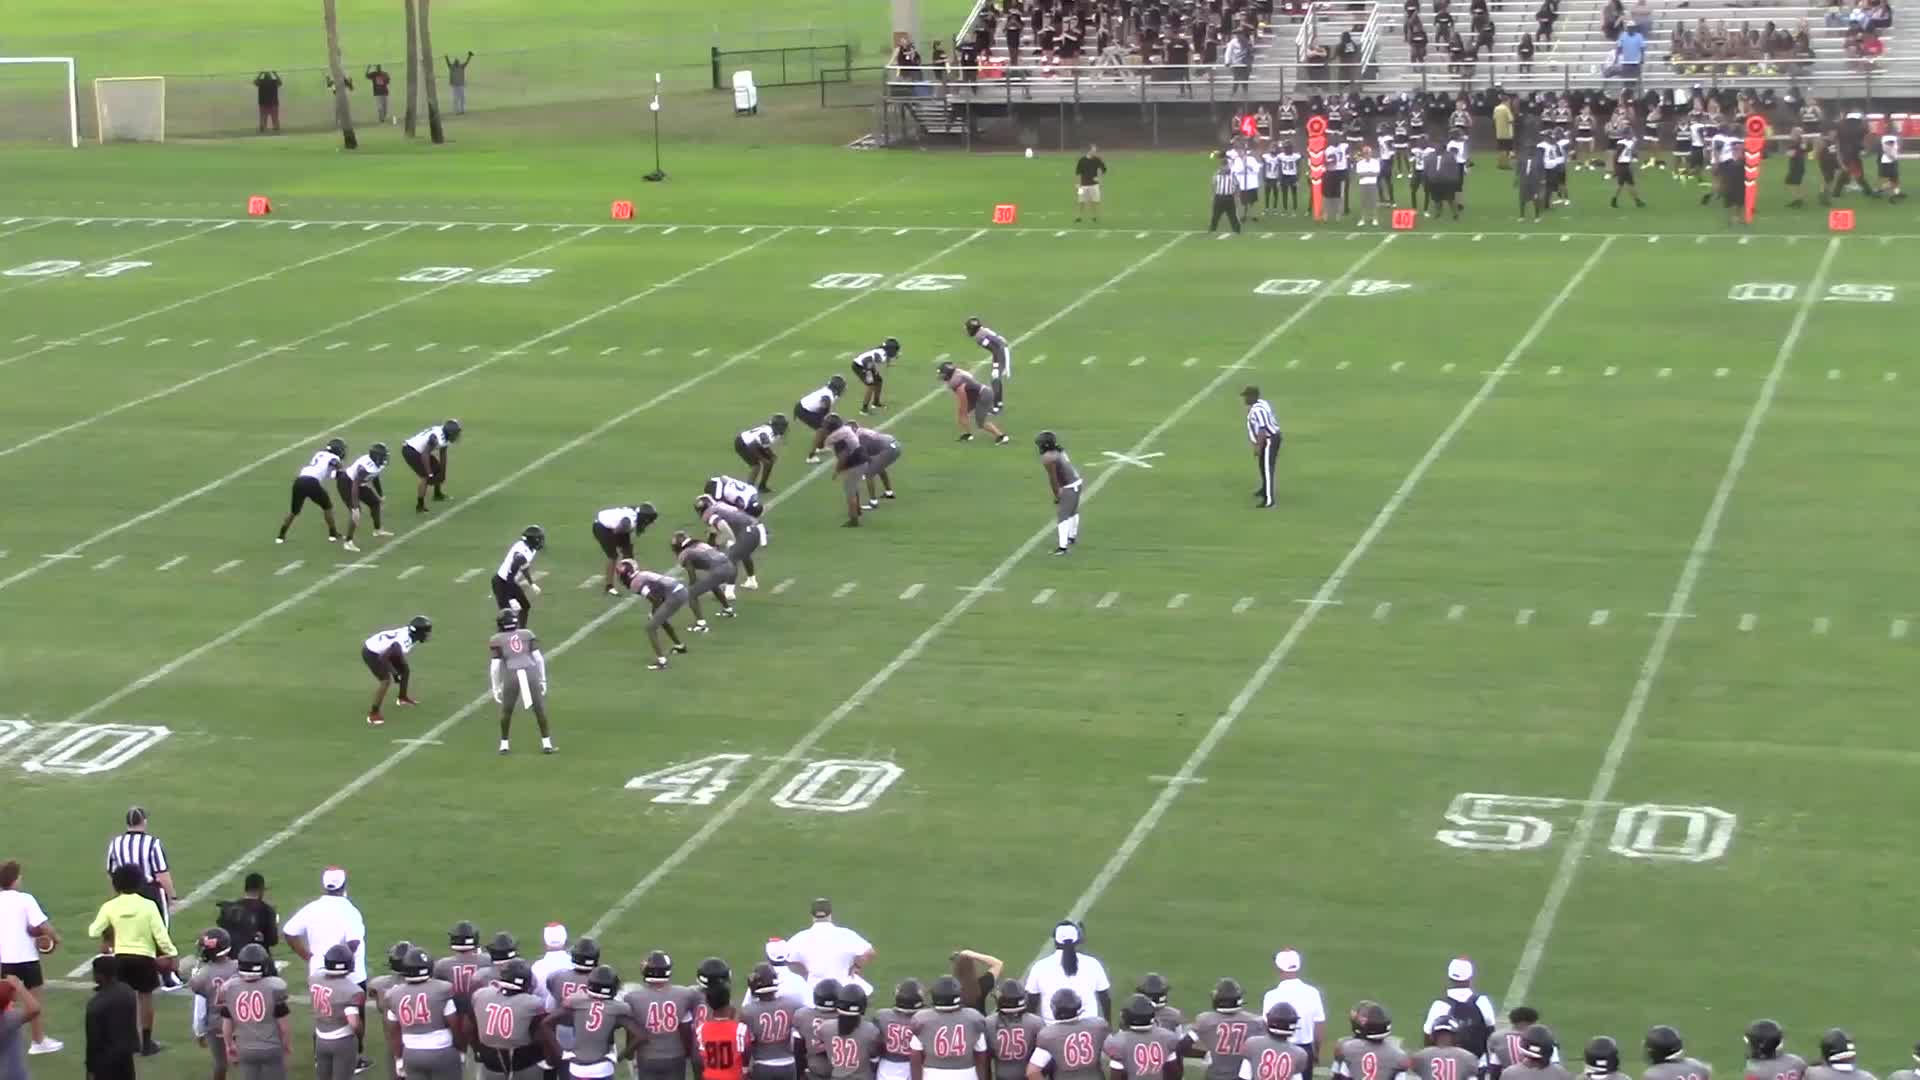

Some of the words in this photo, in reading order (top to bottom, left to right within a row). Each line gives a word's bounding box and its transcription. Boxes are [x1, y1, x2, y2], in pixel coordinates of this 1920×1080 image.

[614, 202, 630, 217] 20
[997, 207, 1012, 222] 30
[624, 753, 905, 812] 40
[1435, 792, 1737, 862] 50
[235, 990, 266, 1023] 60
[399, 992, 431, 1026] 64
[484, 1002, 513, 1039] 70
[585, 1001, 605, 1032] 5
[647, 1000, 679, 1034] 48
[759, 1008, 789, 1043] 22
[933, 1023, 967, 1057] 64
[1216, 1022, 1249, 1056] 27
[705, 1040, 735, 1070] 80
[831, 1035, 860, 1070] 32
[996, 1027, 1027, 1060] 25
[1063, 1030, 1095, 1068] 63
[1133, 1041, 1164, 1076] 99
[1259, 1048, 1293, 1080] 80
[1361, 1051, 1378, 1080] 9
[1431, 1057, 1457, 1080] 31
